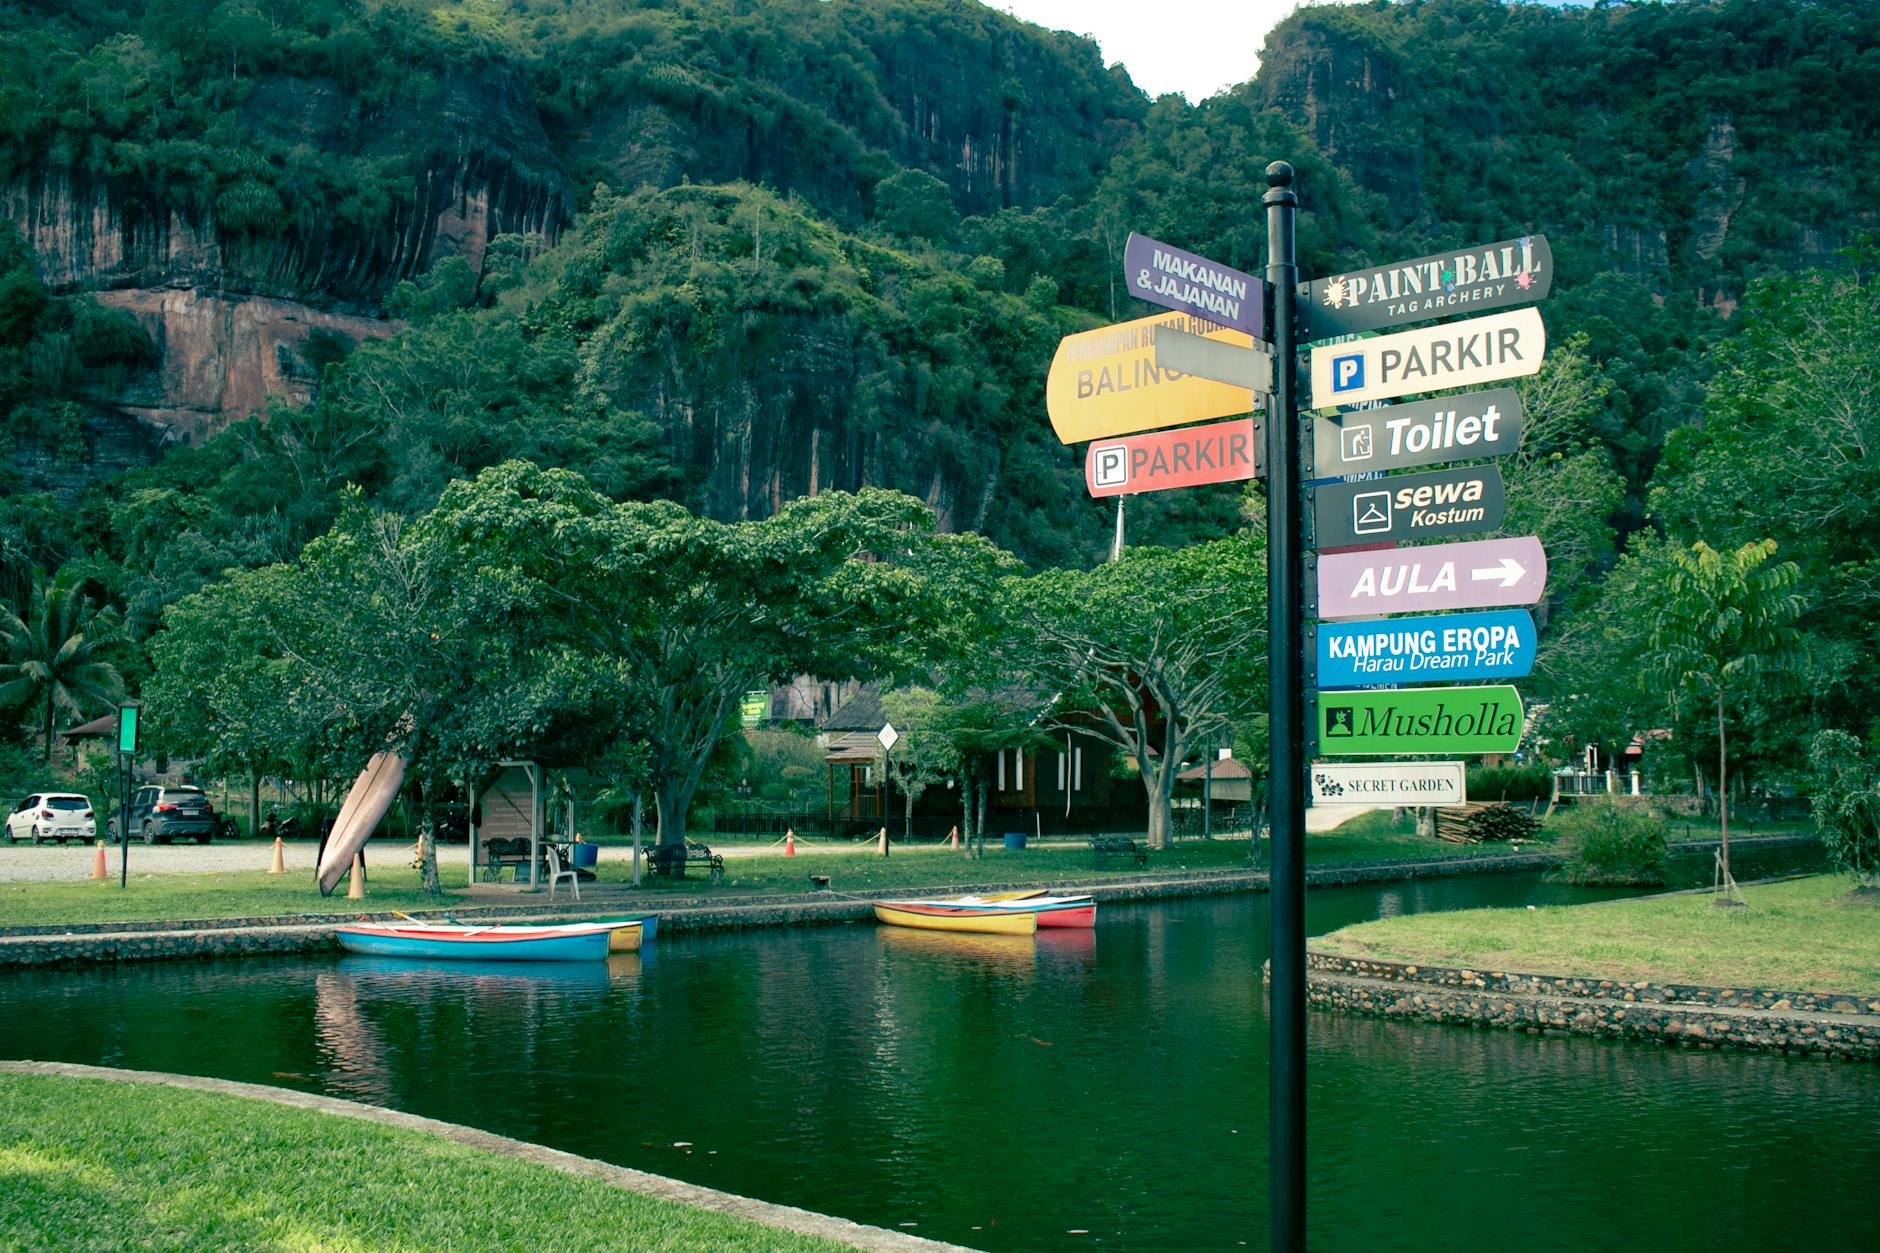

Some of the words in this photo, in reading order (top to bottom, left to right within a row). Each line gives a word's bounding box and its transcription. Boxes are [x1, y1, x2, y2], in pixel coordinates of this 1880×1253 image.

[1153, 249, 1246, 300] MAKANAN
[1347, 261, 1446, 308] PAINT
[1454, 243, 1542, 287] BALL
[1136, 268, 1152, 290] &
[1154, 275, 1240, 320] JAJANAN
[1388, 301, 1418, 316] TAG
[1424, 284, 1506, 310] ARCHERY
[1339, 358, 1358, 387] P
[1381, 327, 1524, 384] PARKIR
[1385, 404, 1501, 456] Toilet
[1103, 454, 1119, 480] P
[1131, 433, 1250, 479] PARKIR
[1394, 478, 1484, 509] sewa
[1410, 506, 1485, 528] Kostum
[1350, 562, 1457, 598] AULA
[1329, 630, 1436, 658] KAMPUNG
[1444, 625, 1520, 653] EROPA
[1353, 655, 1405, 673] Harau
[1410, 652, 1469, 669] Dream
[1474, 648, 1514, 667] Park
[1356, 702, 1516, 737] Musholla
[1348, 779, 1398, 792] SECRET
[1400, 778, 1455, 792] GARDEN
